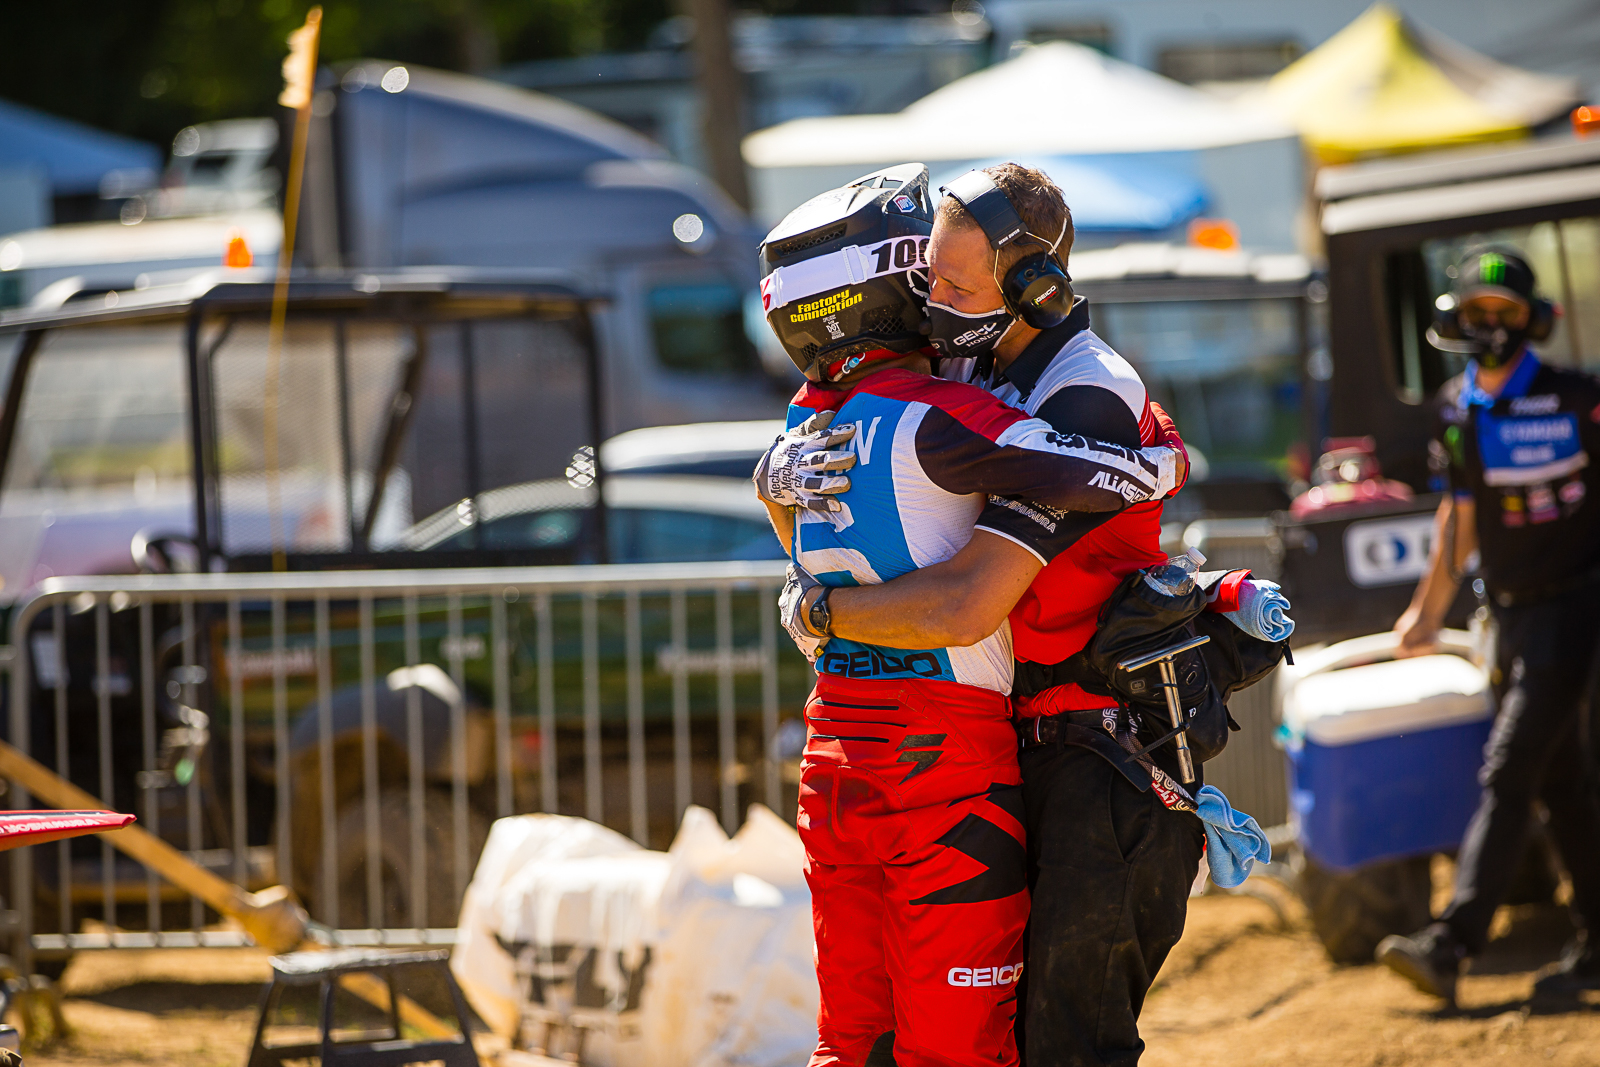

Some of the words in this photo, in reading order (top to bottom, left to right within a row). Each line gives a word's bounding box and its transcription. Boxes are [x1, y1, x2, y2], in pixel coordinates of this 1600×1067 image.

[790, 292, 863, 323] Connection
[797, 289, 850, 314] Factory
[966, 329, 1001, 348] HONDA
